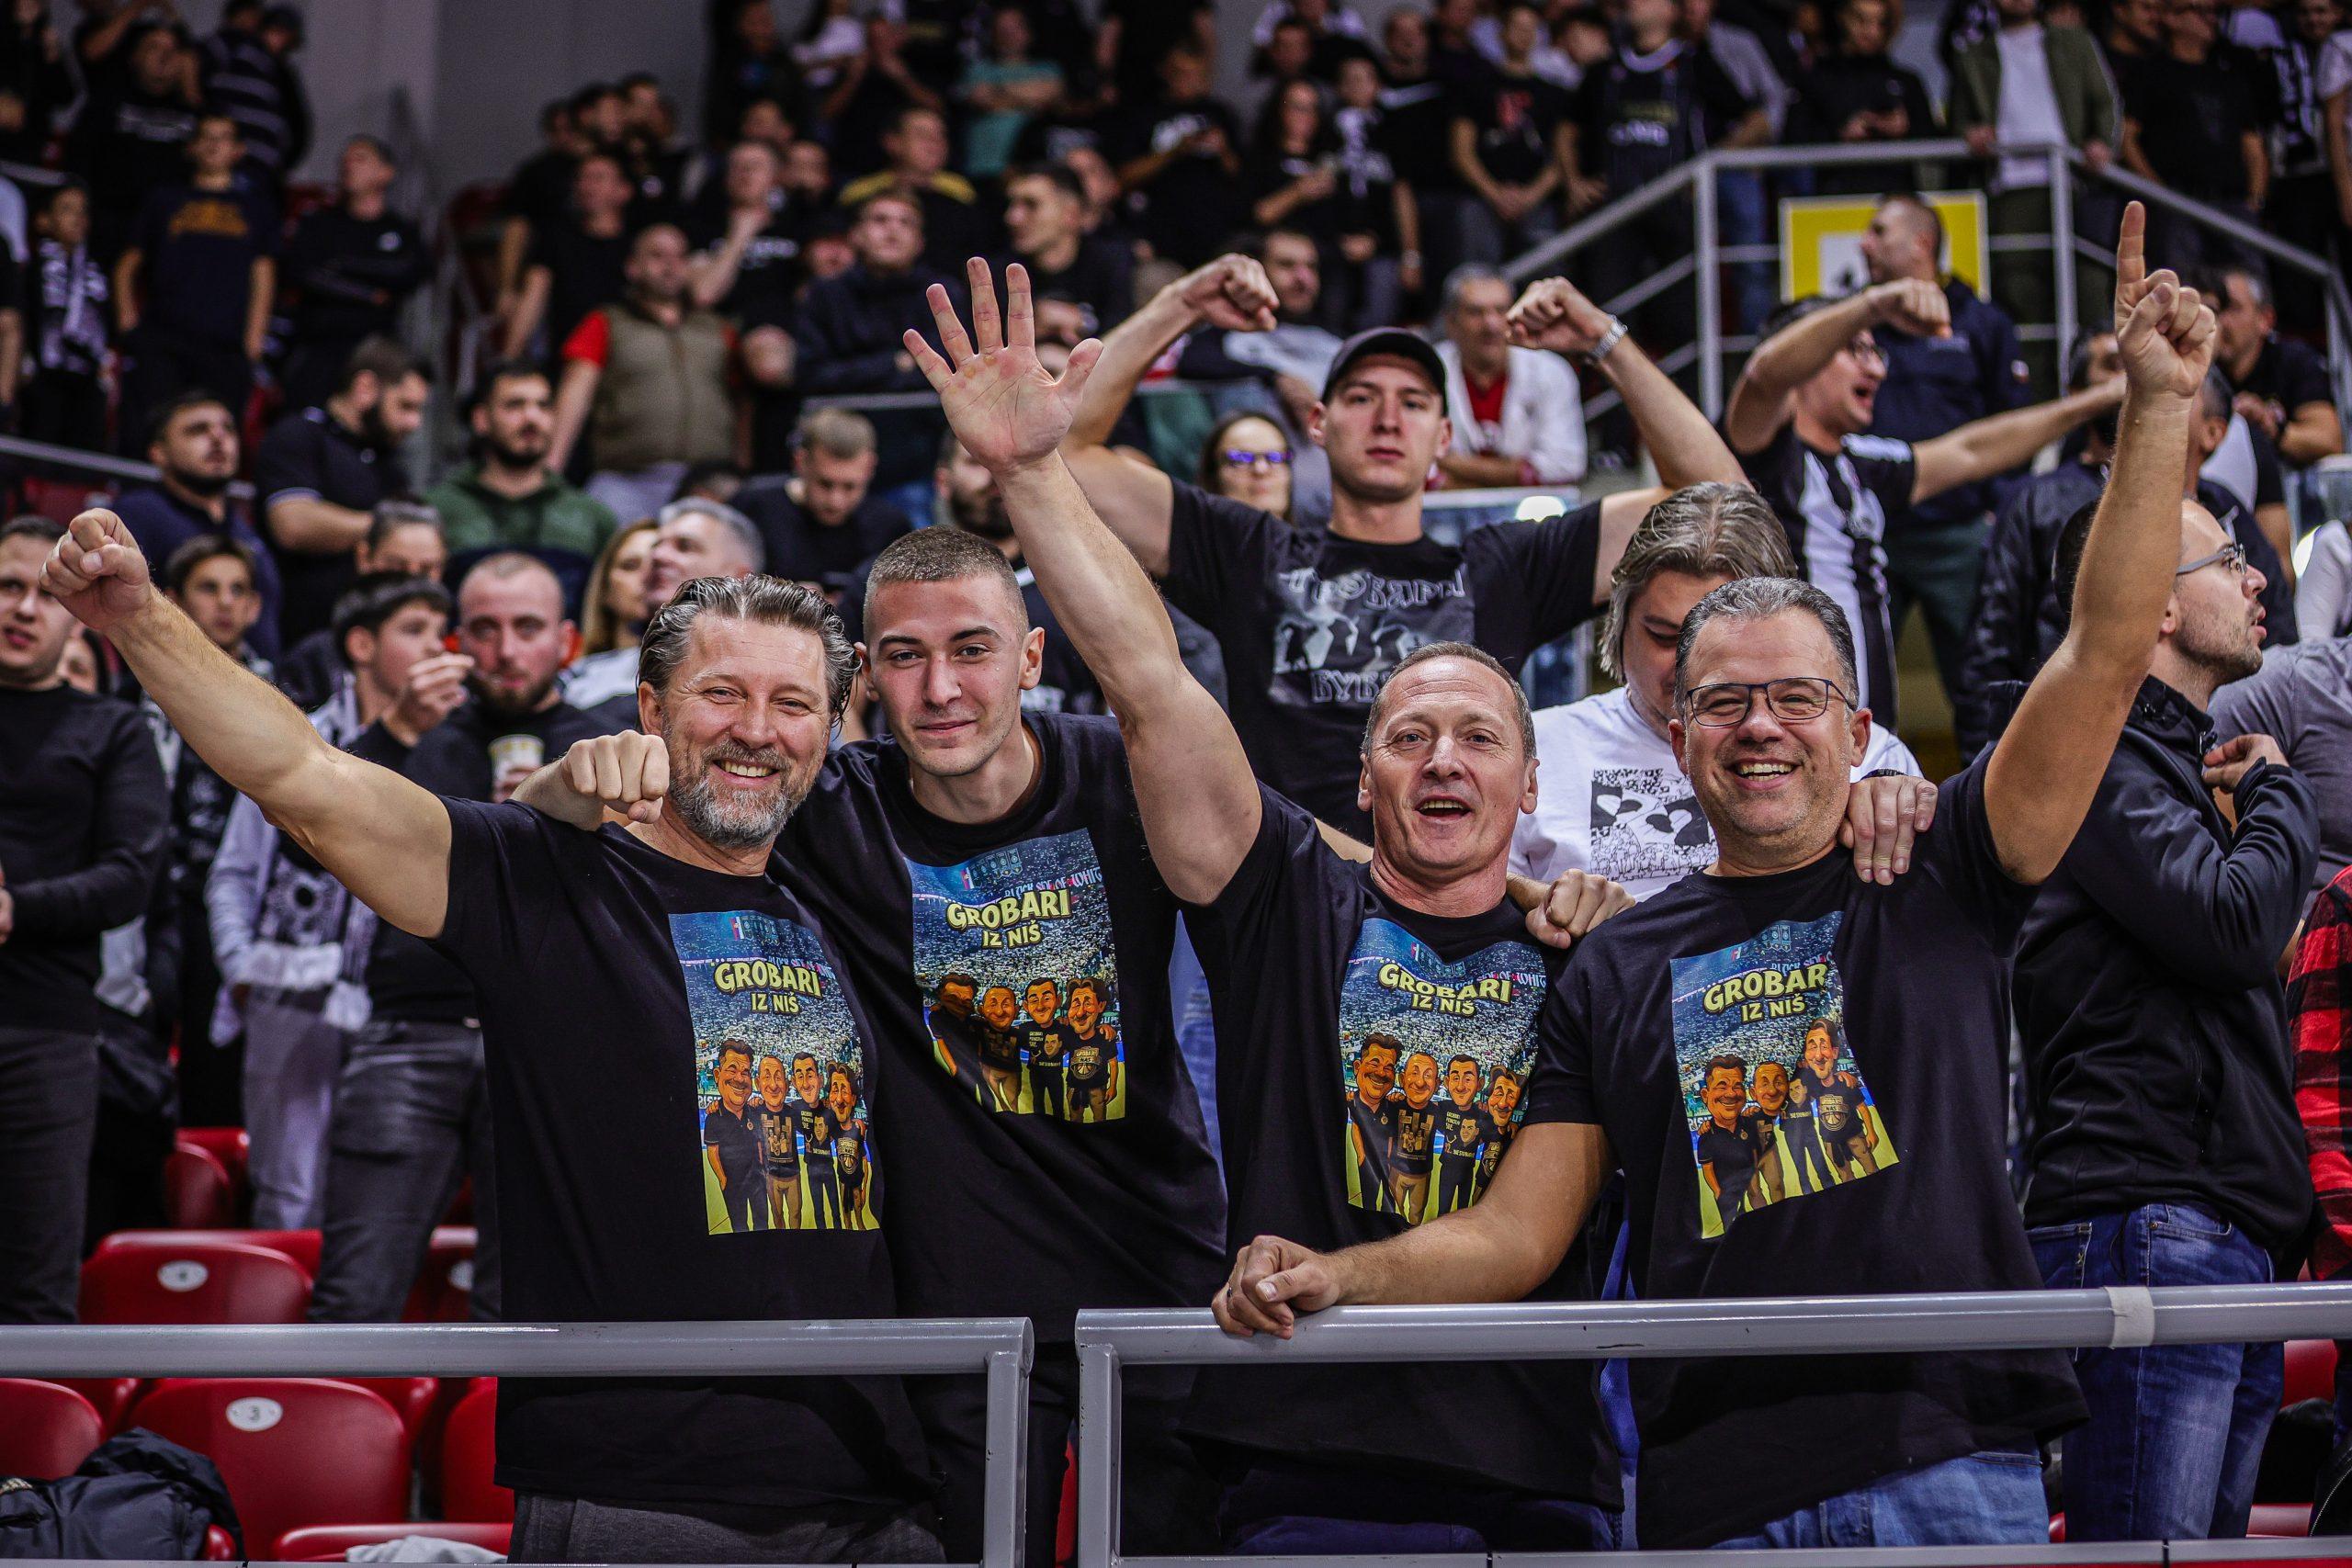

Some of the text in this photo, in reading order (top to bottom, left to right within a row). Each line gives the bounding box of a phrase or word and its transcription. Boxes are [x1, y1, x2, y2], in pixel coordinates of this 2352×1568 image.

[946, 888, 1071, 931] GROBARI
[982, 919, 1043, 949] IZ NIŠ
[714, 959, 823, 999] GROBARI
[1378, 963, 1512, 1005] GROBARI
[752, 991, 800, 1014] IZ NIŠ
[1411, 994, 1476, 1017] IZ NIŠ
[1741, 993, 1806, 1023] IZ NIŠ
